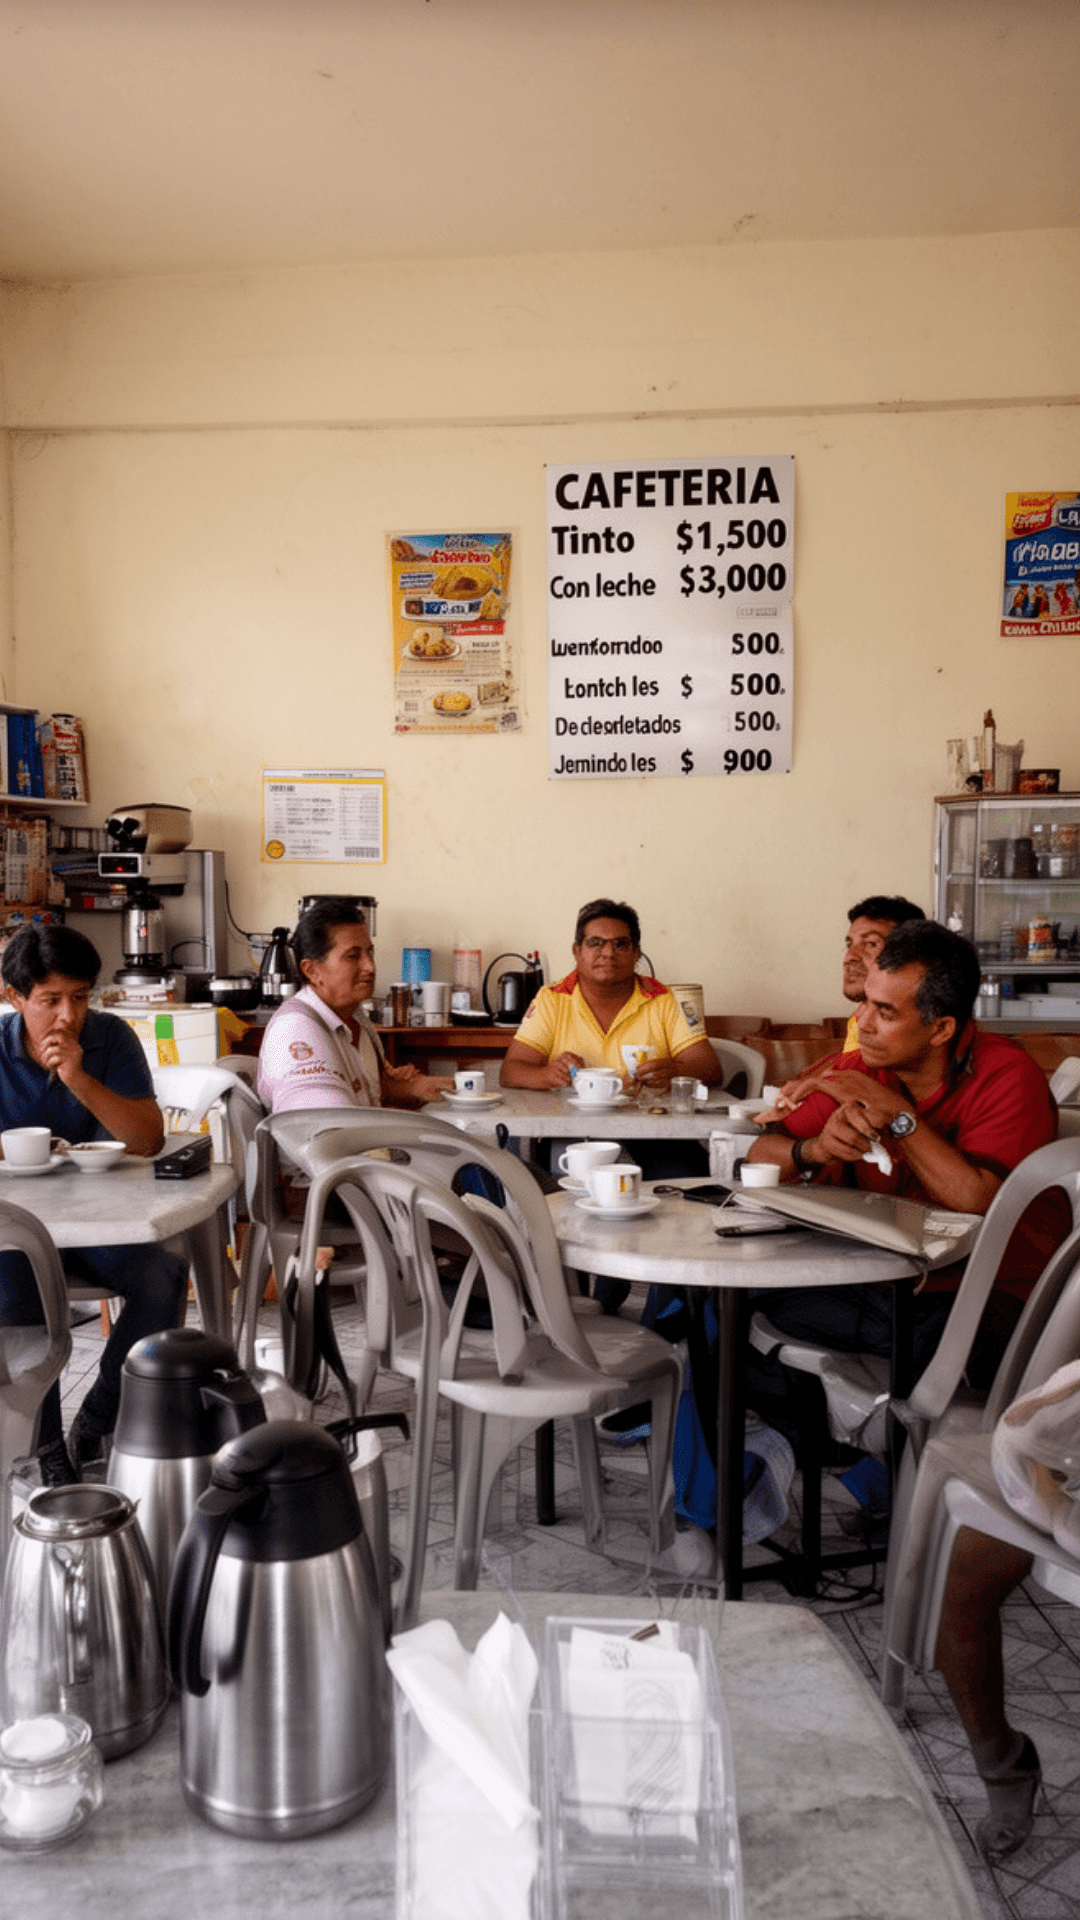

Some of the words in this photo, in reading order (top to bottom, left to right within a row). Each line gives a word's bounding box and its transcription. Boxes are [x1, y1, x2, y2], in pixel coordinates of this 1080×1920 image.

[555, 466, 781, 511] CAFETERIA
[551, 524, 635, 556] Tinto
[676, 518, 787, 557] $1,500
[549, 575, 590, 600] Con
[595, 572, 657, 598] leche
[679, 562, 787, 600] $3,000
[680, 674, 693, 699] $
[680, 748, 695, 775] $
[723, 748, 773, 775] 900
